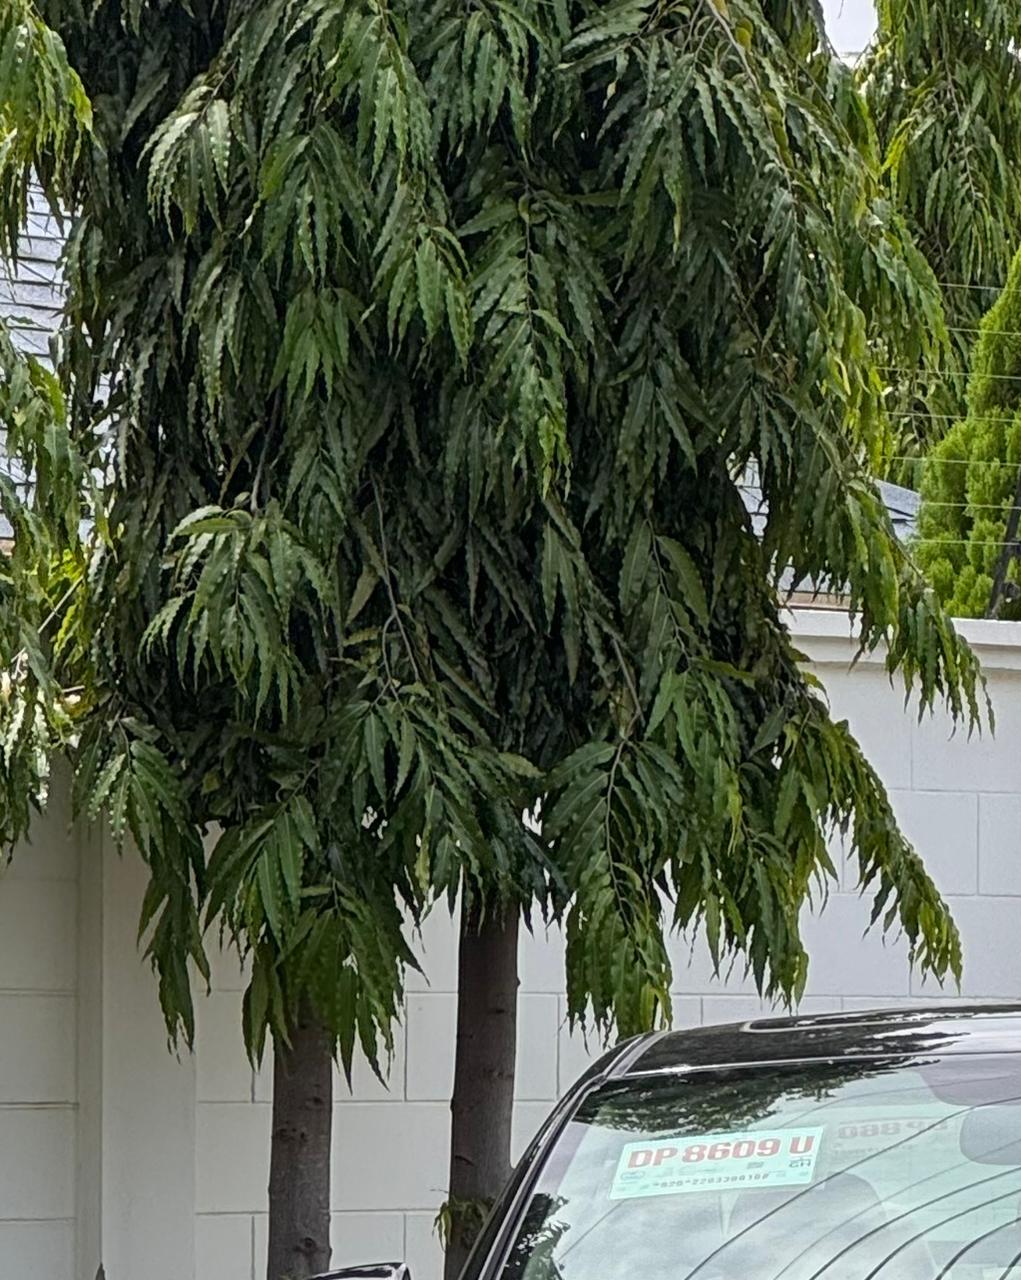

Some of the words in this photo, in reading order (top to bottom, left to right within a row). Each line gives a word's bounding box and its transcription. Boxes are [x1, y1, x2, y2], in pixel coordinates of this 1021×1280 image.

[627, 1147, 677, 1169] DP
[682, 1138, 781, 1163] 8609
[789, 1136, 816, 1155] U
